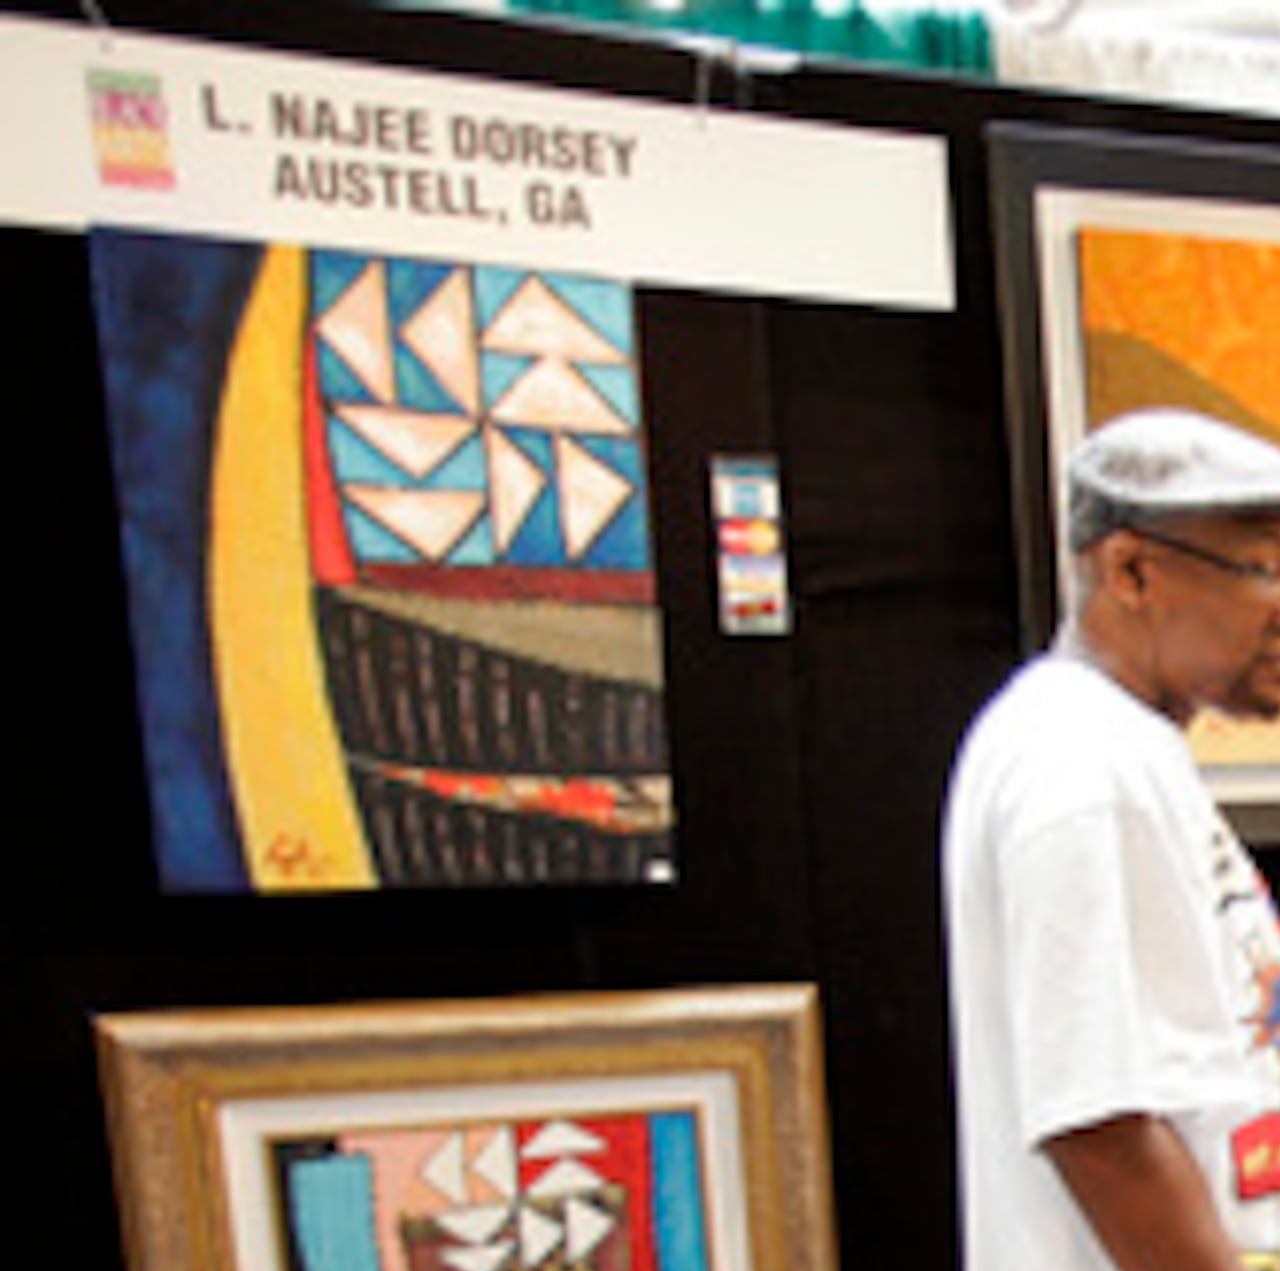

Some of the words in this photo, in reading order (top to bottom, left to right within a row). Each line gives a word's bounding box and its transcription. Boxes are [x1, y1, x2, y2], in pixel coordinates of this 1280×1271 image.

[201, 84, 252, 134] L.
[270, 92, 431, 154] NAJEE
[449, 114, 637, 176] DORSEY
[273, 153, 508, 225] AUSTELL,
[526, 180, 592, 230] GA
